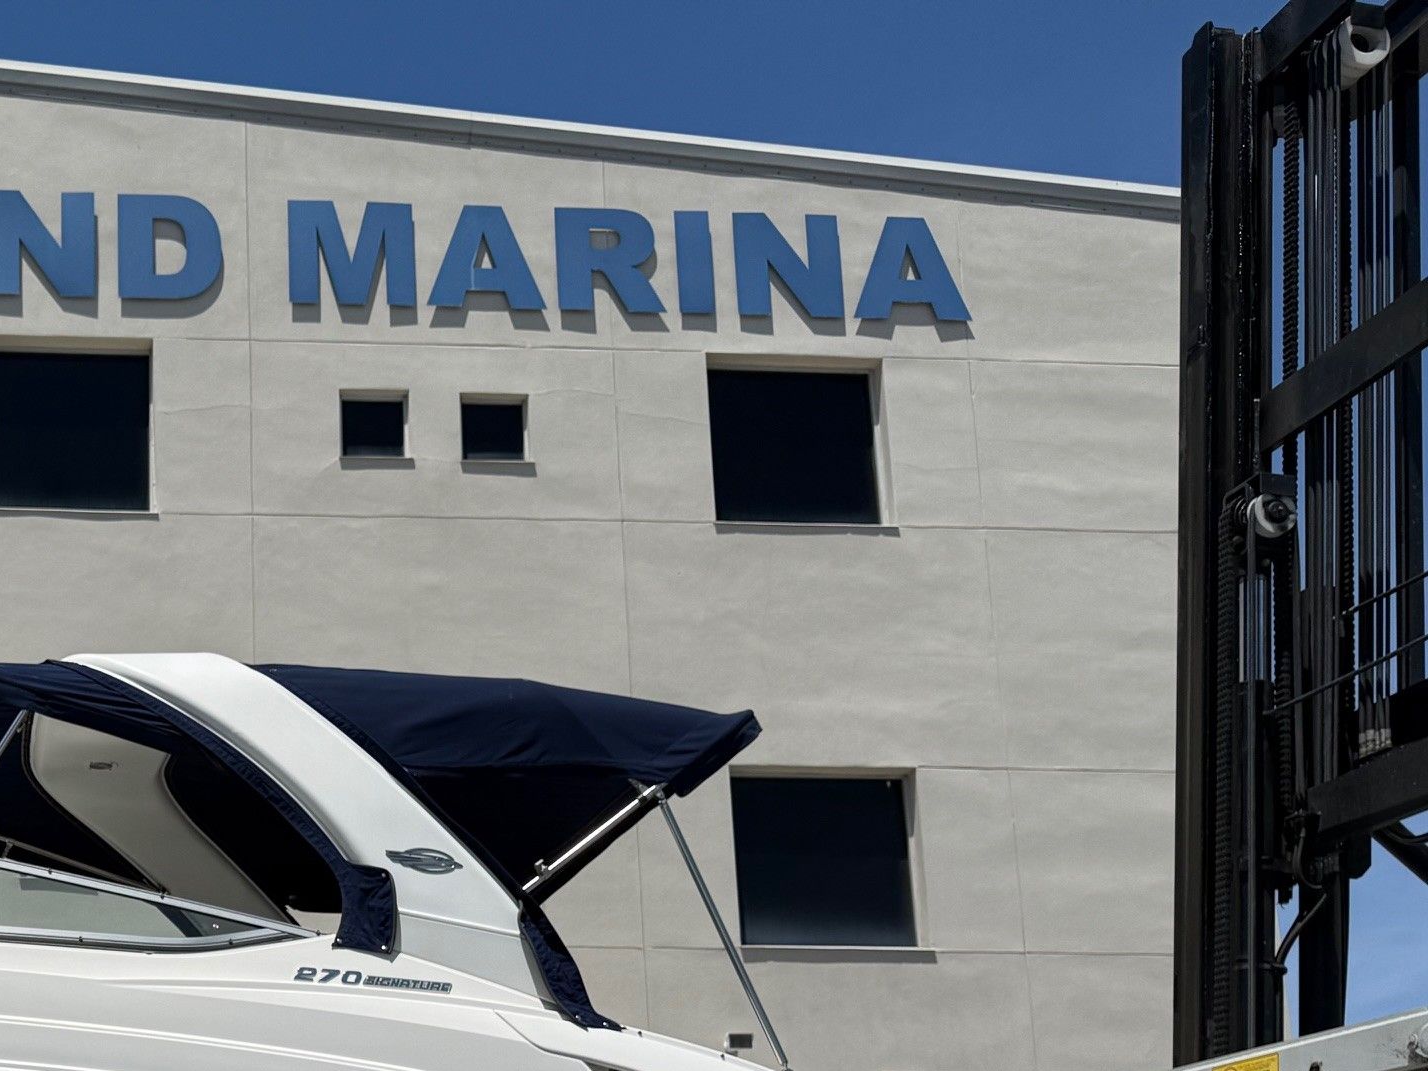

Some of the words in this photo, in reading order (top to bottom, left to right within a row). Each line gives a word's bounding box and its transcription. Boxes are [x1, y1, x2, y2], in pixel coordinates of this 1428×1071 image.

[287, 199, 972, 322] MARINA
[293, 966, 363, 986] 270
[363, 975, 453, 995] SIGNATURE
